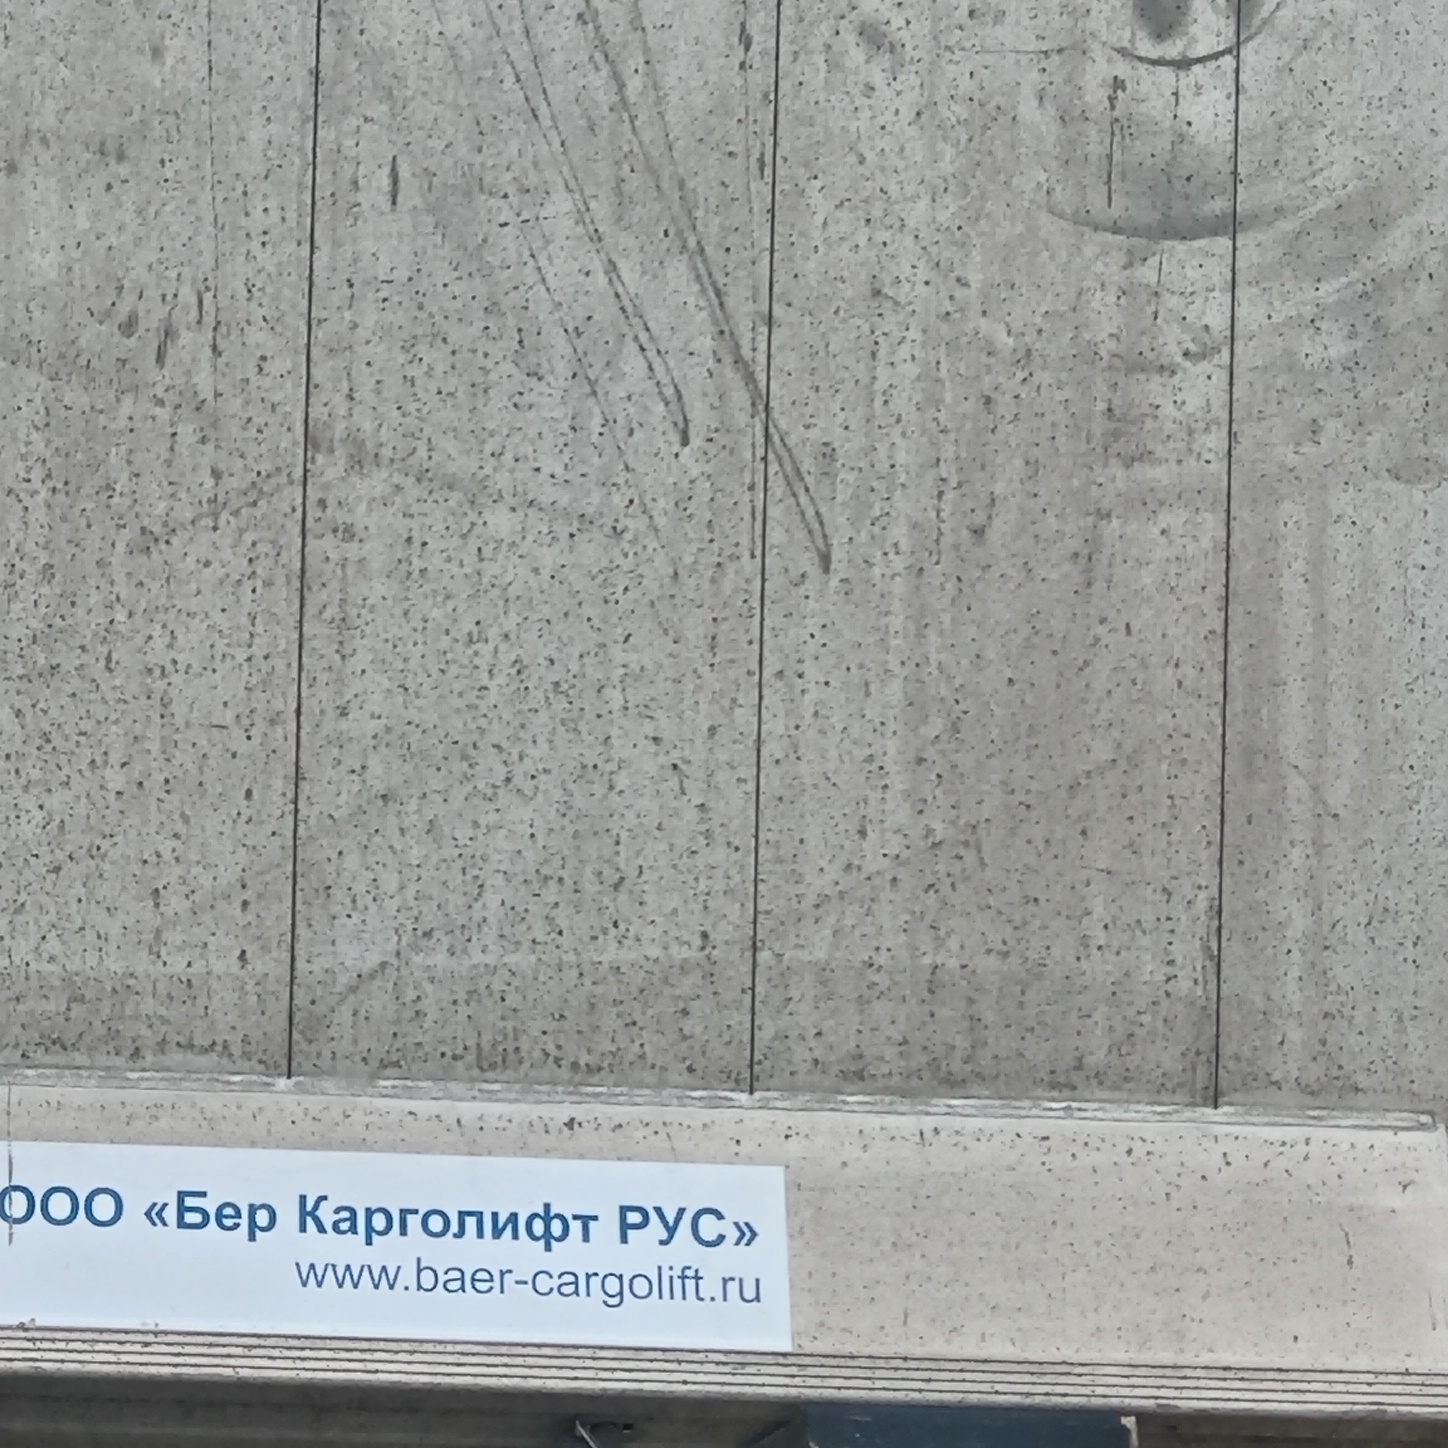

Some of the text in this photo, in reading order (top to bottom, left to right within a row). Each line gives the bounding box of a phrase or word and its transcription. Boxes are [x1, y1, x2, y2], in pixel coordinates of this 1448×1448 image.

[144, 1189, 278, 1242] «Бер
[297, 1194, 598, 1253] Карголифт
[618, 1205, 761, 1249] РУС»
[295, 1258, 762, 1308] www.baer-cargolift.ru
